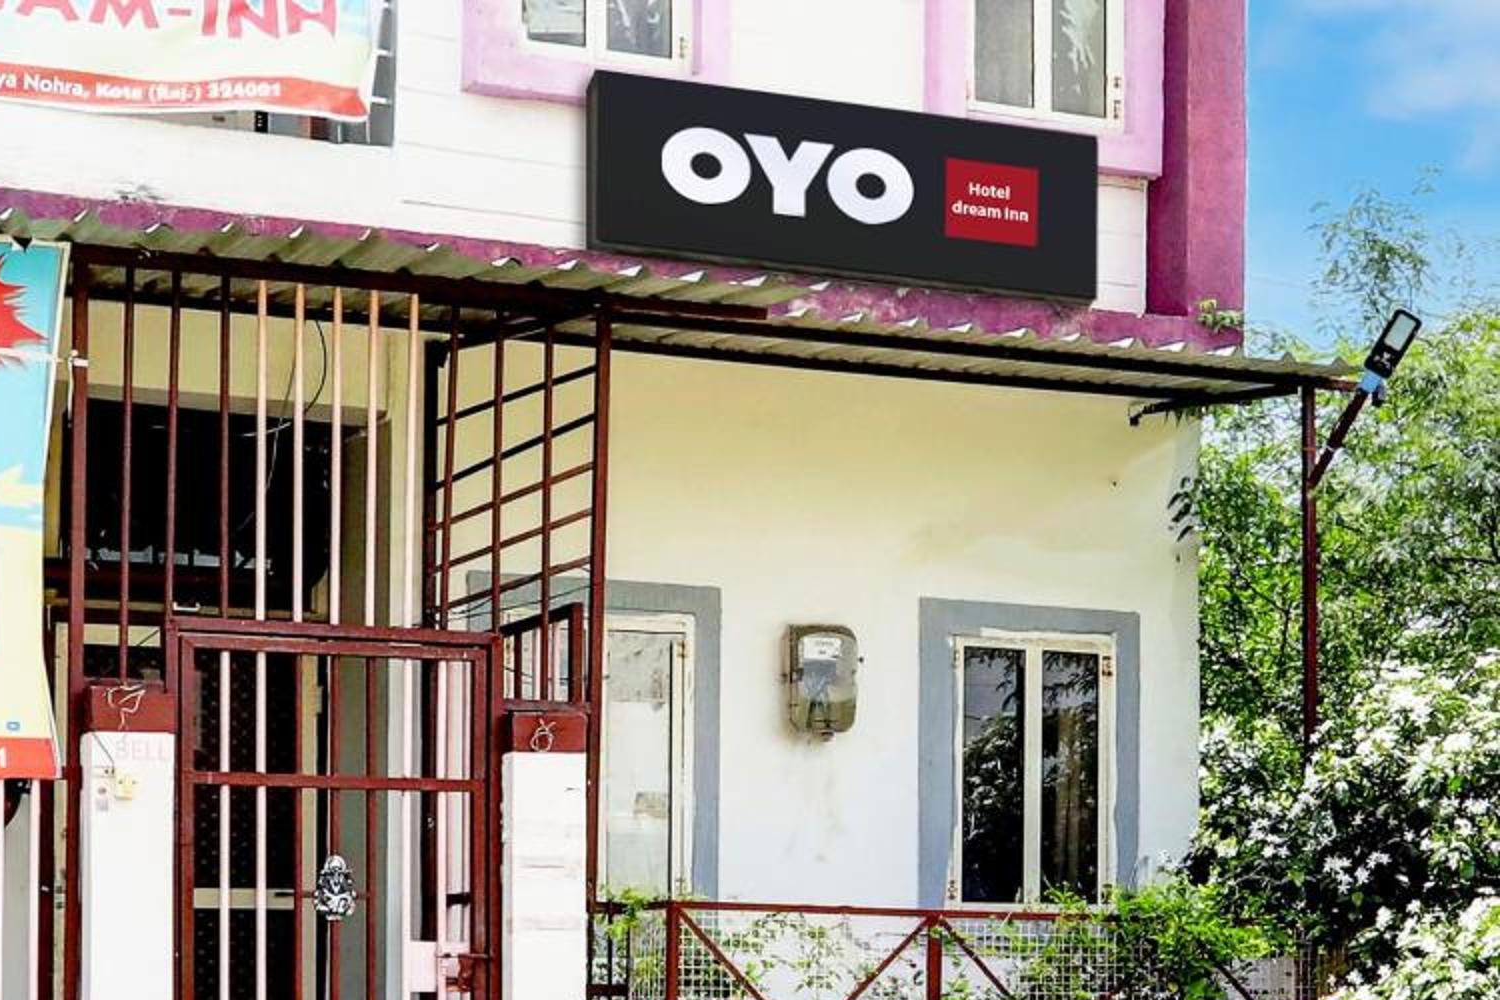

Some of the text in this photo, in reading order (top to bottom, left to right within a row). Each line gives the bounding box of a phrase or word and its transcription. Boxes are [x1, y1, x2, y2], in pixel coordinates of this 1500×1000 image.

[23, 74, 90, 97] Nohra,
[207, 81, 281, 98] 324001
[660, 126, 915, 225] OYO
[968, 181, 1011, 200] Hotel
[951, 200, 1001, 219] dream
